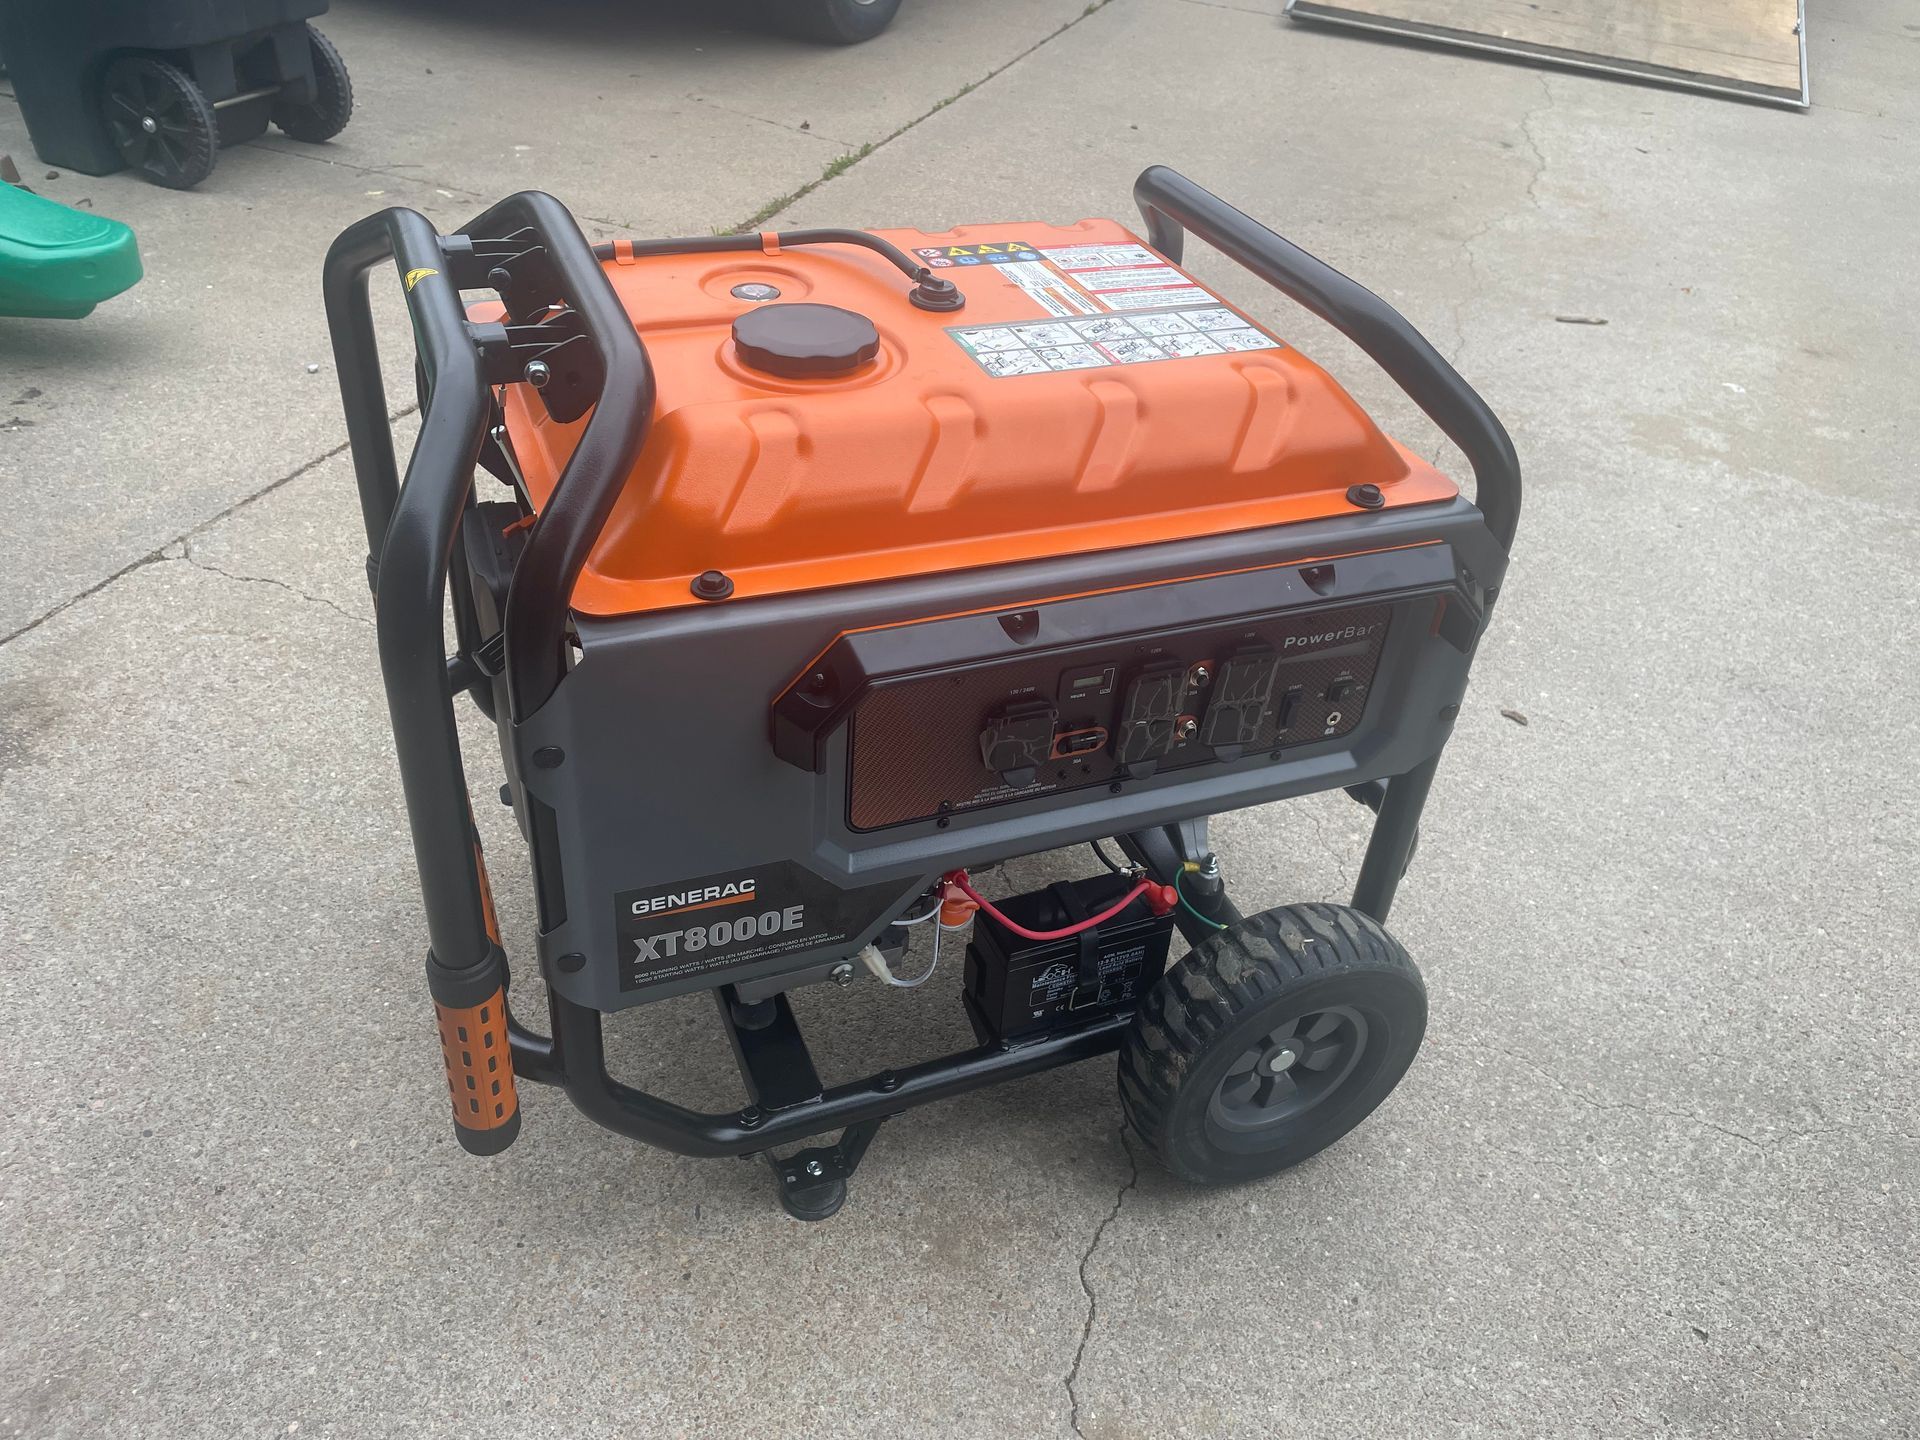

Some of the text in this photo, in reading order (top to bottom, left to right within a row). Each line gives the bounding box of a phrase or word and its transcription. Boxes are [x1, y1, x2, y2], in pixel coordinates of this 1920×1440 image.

[1284, 625, 1376, 649] PowerBar
[631, 879, 756, 915] GENERAC
[633, 904, 805, 964] XT8000E
[650, 965, 679, 976] RUNNING
[679, 961, 700, 969] WATTS
[768, 939, 799, 950] CONSUMO
[808, 933, 828, 941] VATIOS
[653, 969, 683, 980] STARTING
[684, 965, 705, 973] WATTS
[709, 960, 730, 968] WATTS
[784, 943, 805, 951] VATIOS
